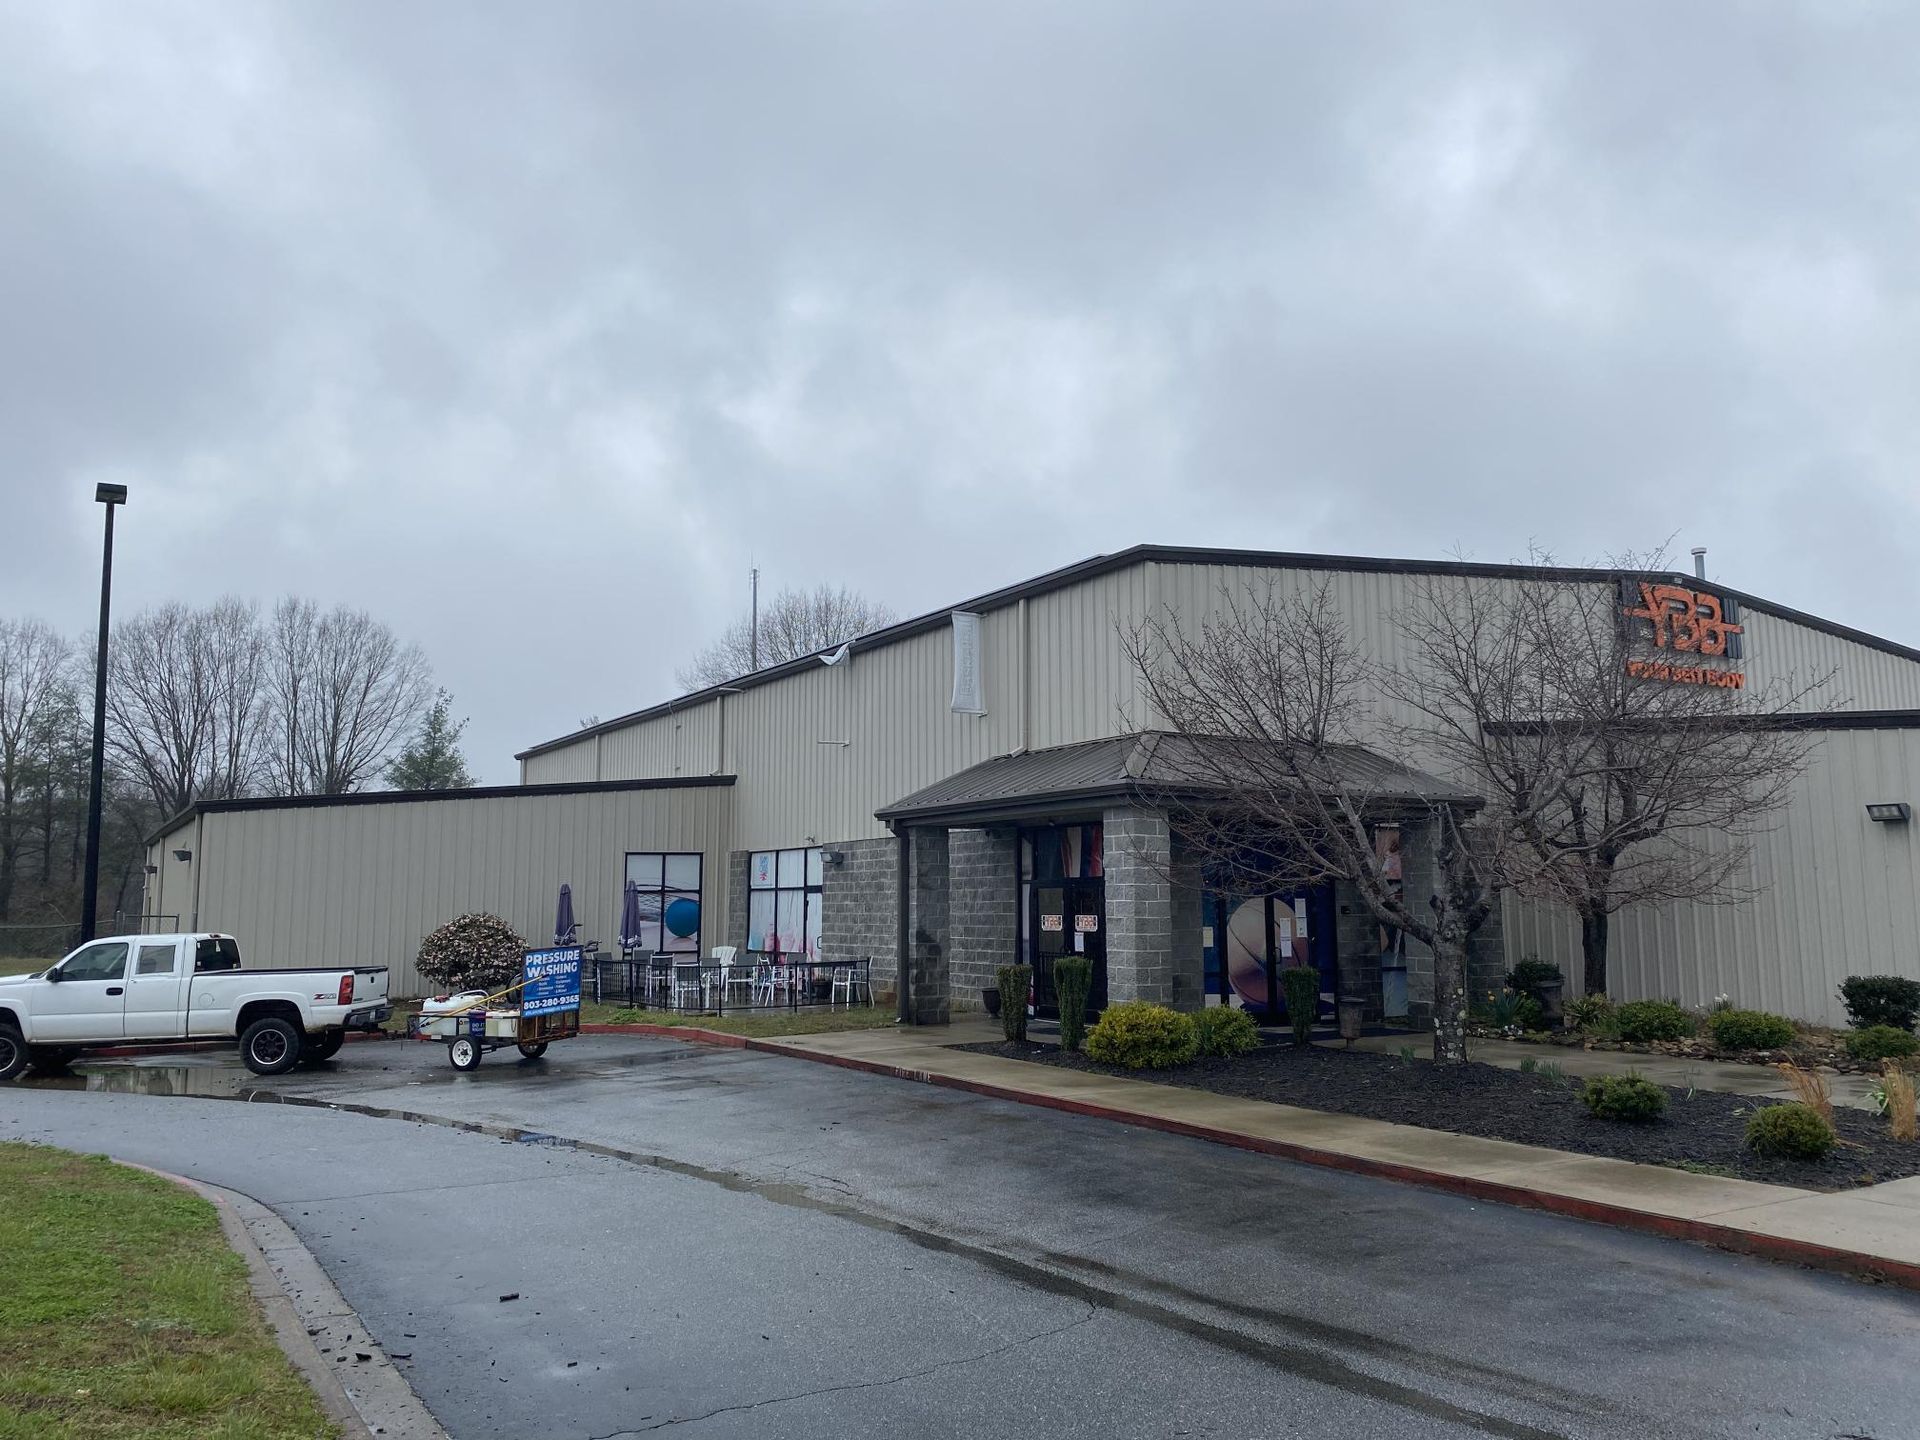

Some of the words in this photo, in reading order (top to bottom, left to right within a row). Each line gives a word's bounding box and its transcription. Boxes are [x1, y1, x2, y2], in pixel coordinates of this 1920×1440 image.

[526, 950, 580, 966] PRESSURE
[526, 962, 578, 978] WASHING
[523, 995, 580, 1010] 803-280-9365
